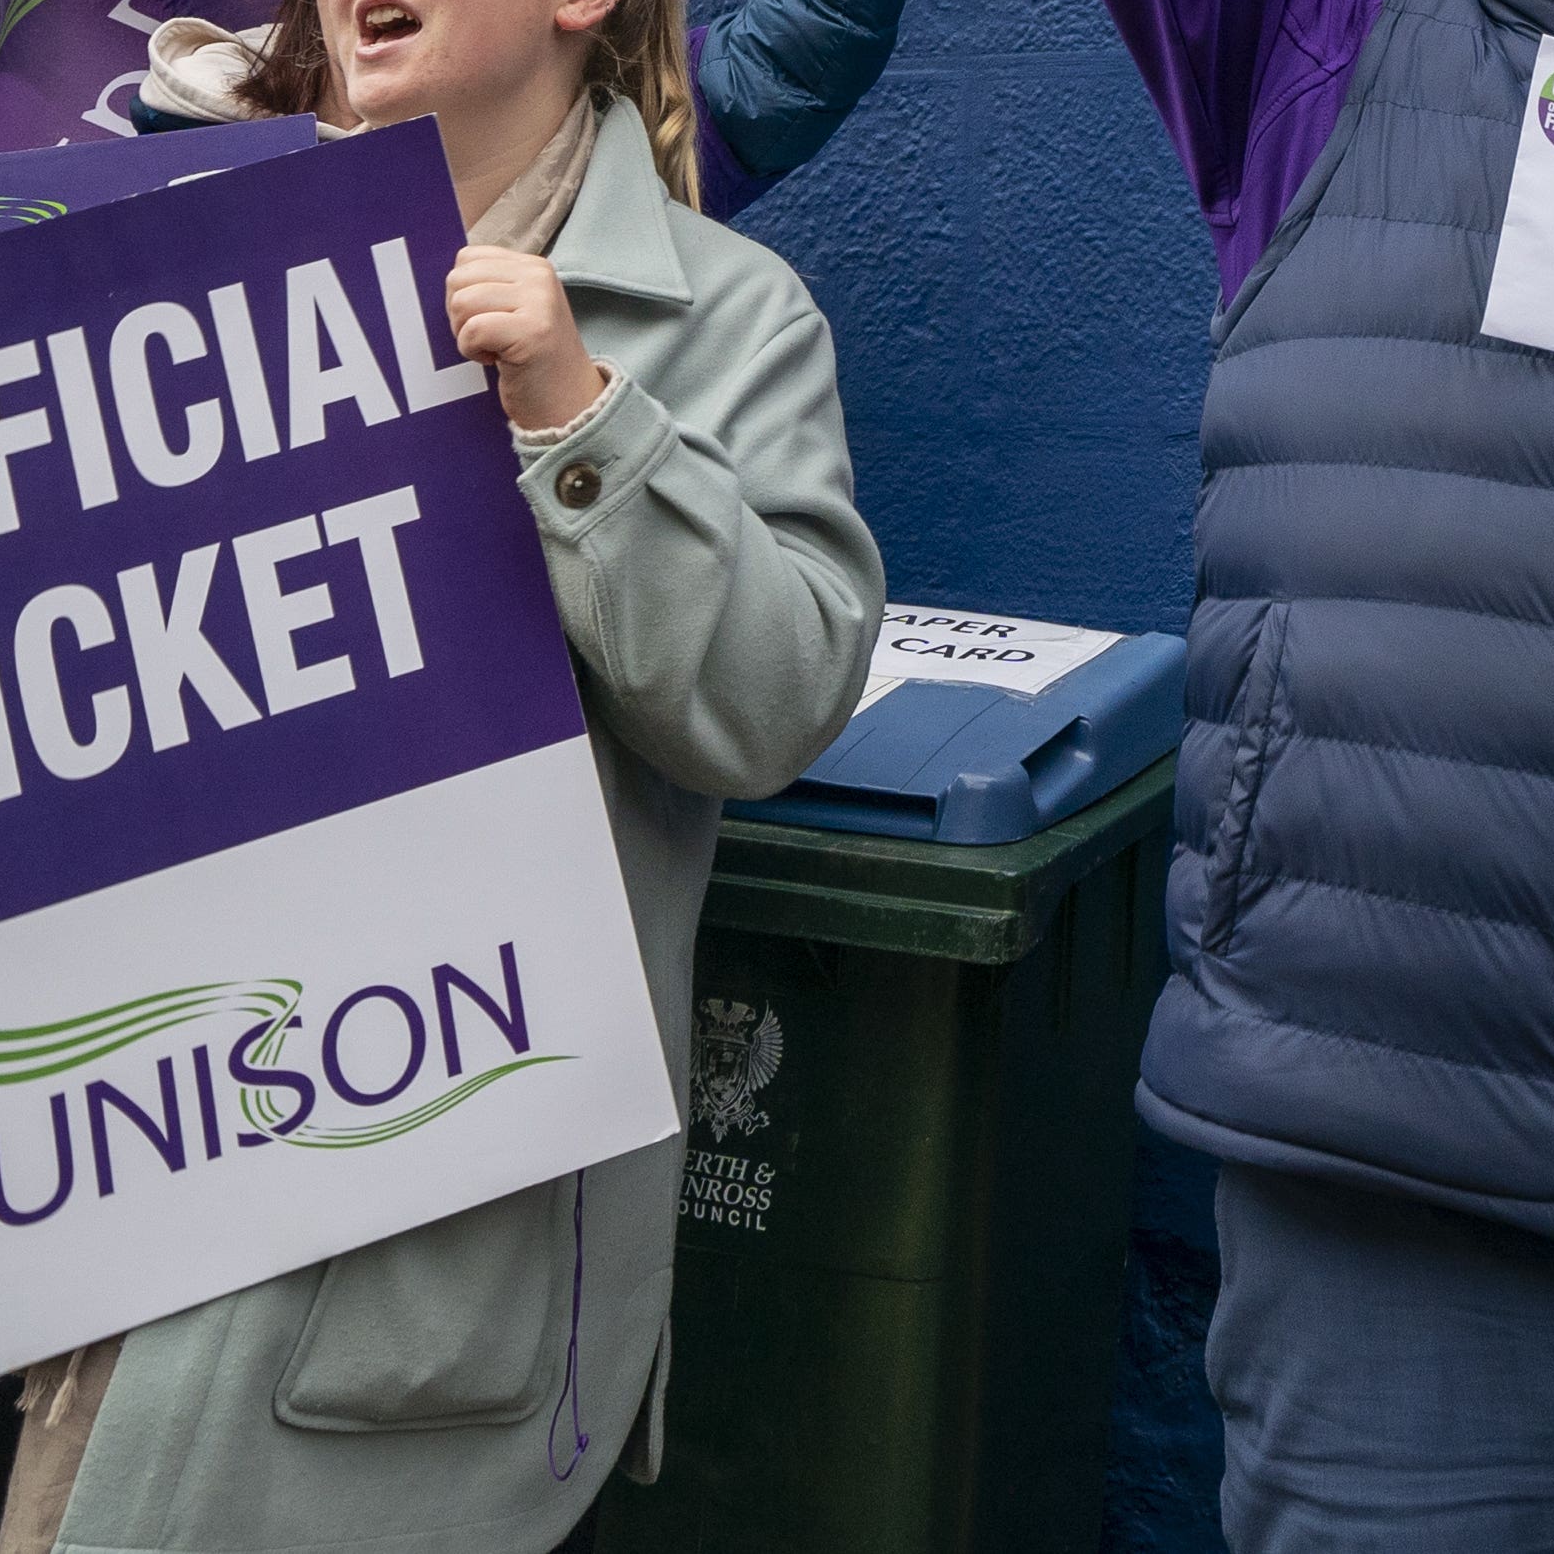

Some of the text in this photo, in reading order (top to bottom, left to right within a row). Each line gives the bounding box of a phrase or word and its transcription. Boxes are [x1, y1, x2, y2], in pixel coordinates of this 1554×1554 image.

[883, 612, 1018, 638] APER
[890, 638, 1035, 662] CARD
[754, 1162, 775, 1184] &
